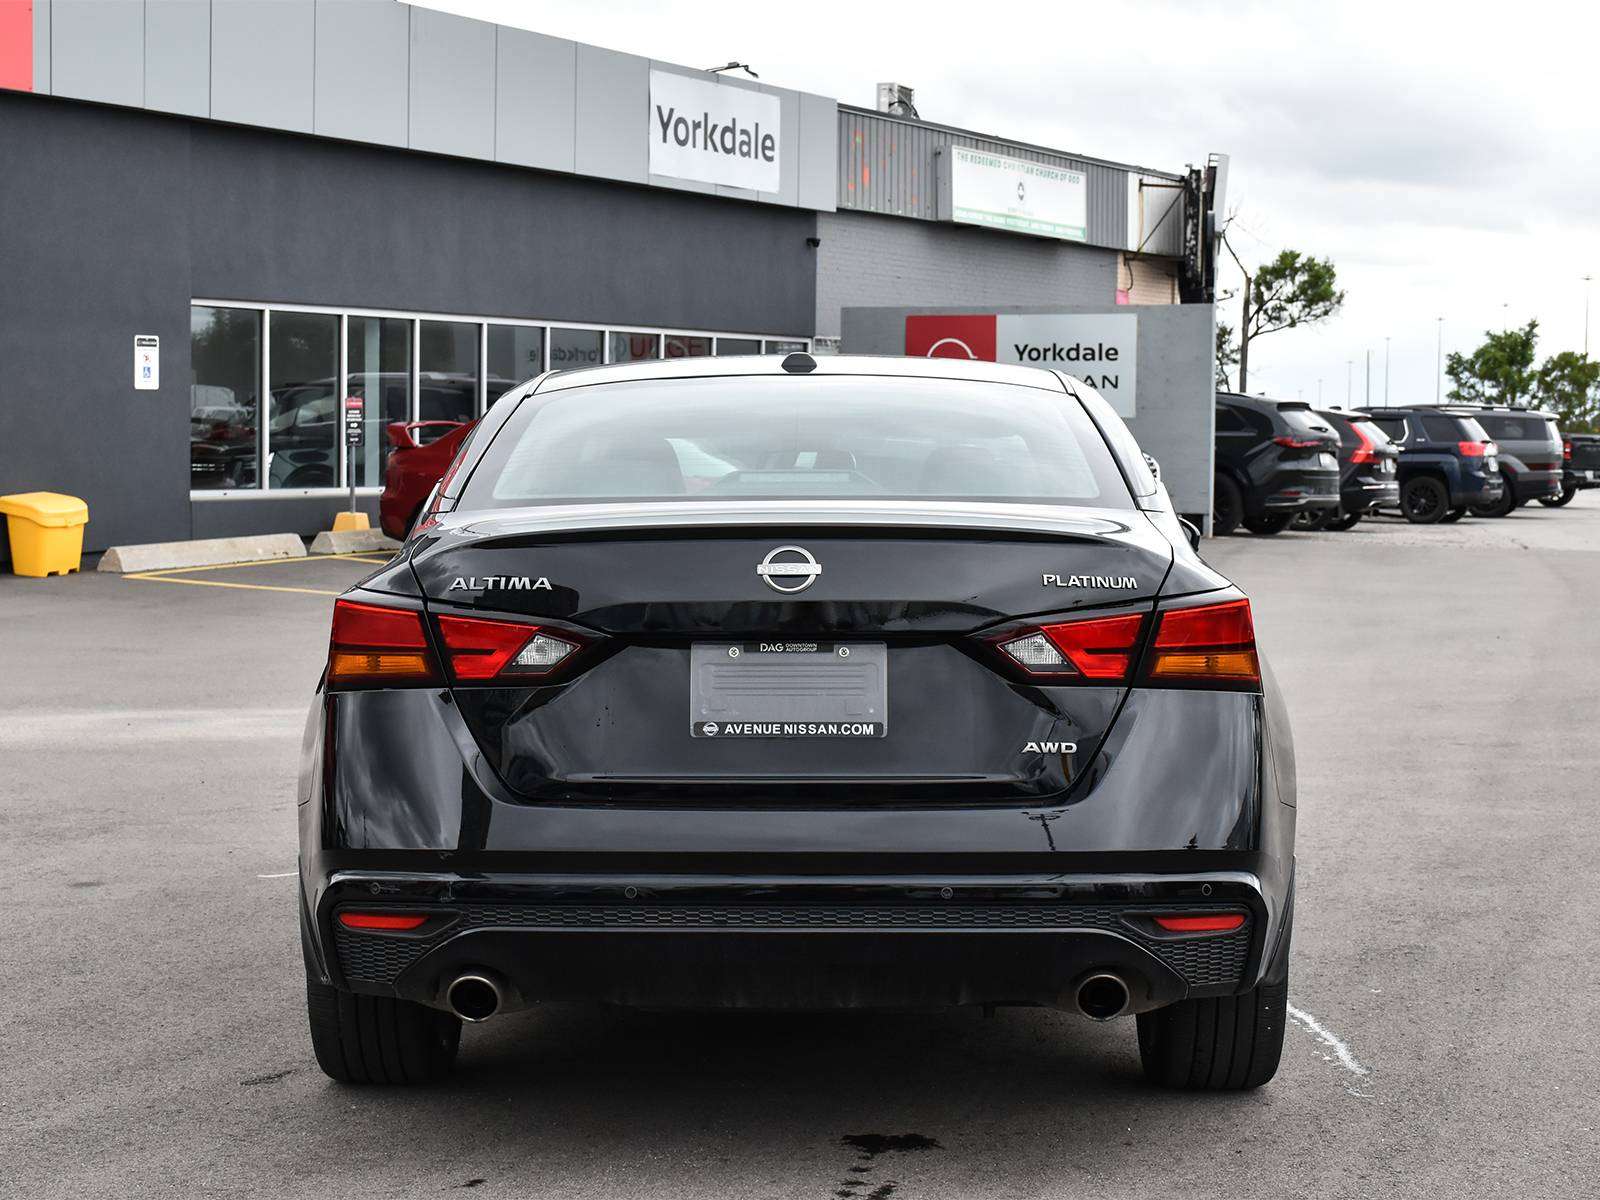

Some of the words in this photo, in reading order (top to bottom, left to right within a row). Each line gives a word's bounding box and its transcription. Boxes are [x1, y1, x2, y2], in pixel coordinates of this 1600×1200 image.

[656, 105, 775, 163] Yorkdale
[1014, 343, 1119, 362] Yorkdale
[759, 564, 821, 574] NISSAN
[449, 577, 553, 590] ALTIMA
[1042, 574, 1138, 589] PLATINUM
[760, 643, 784, 652] DAG
[724, 723, 781, 735] AVENUE
[784, 723, 874, 735] NISSAN.COM
[1021, 741, 1077, 753] AWD
